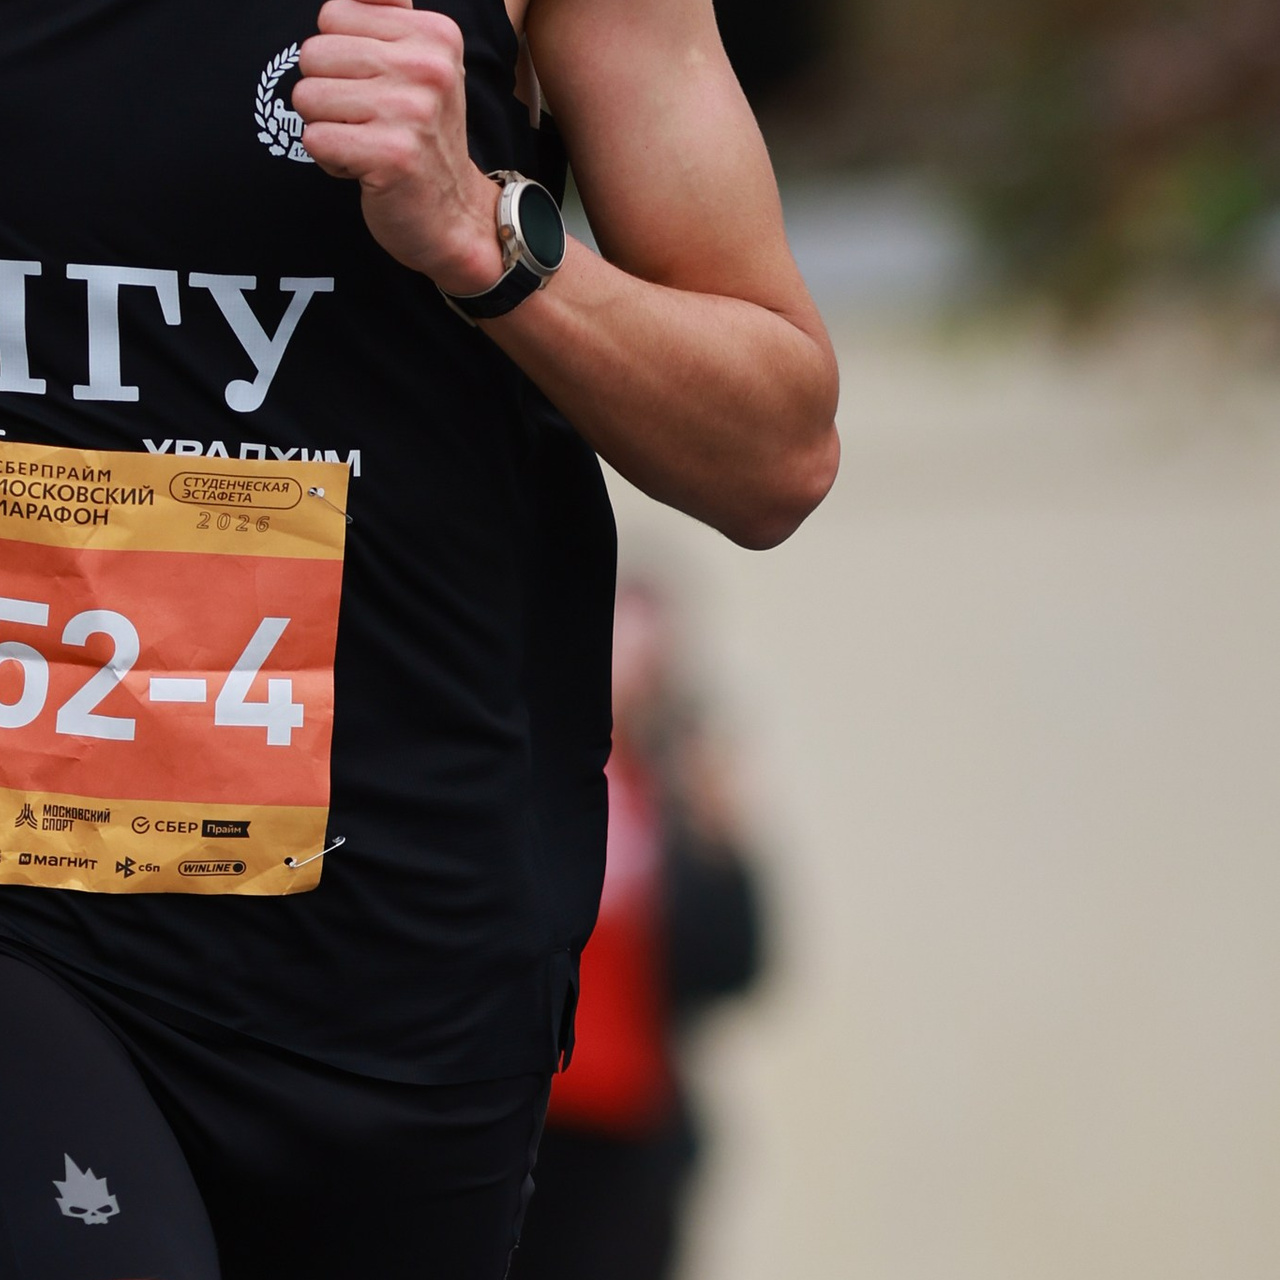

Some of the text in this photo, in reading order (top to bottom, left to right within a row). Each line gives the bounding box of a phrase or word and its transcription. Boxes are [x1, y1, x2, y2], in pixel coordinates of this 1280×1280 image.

[294, 147, 312, 158] 17
[183, 477, 290, 493] СТУДЕНЧЕСКАЯ
[182, 489, 252, 503] ЭСТАФЕТА
[196, 511, 270, 532] 2026
[43, 804, 111, 823] МОСКОВСКИЙ
[42, 818, 75, 832] СПОРТ
[154, 820, 242, 835] СБЕР Прайм
[138, 863, 160, 872] сбп
[183, 863, 231, 873] WINLINE
